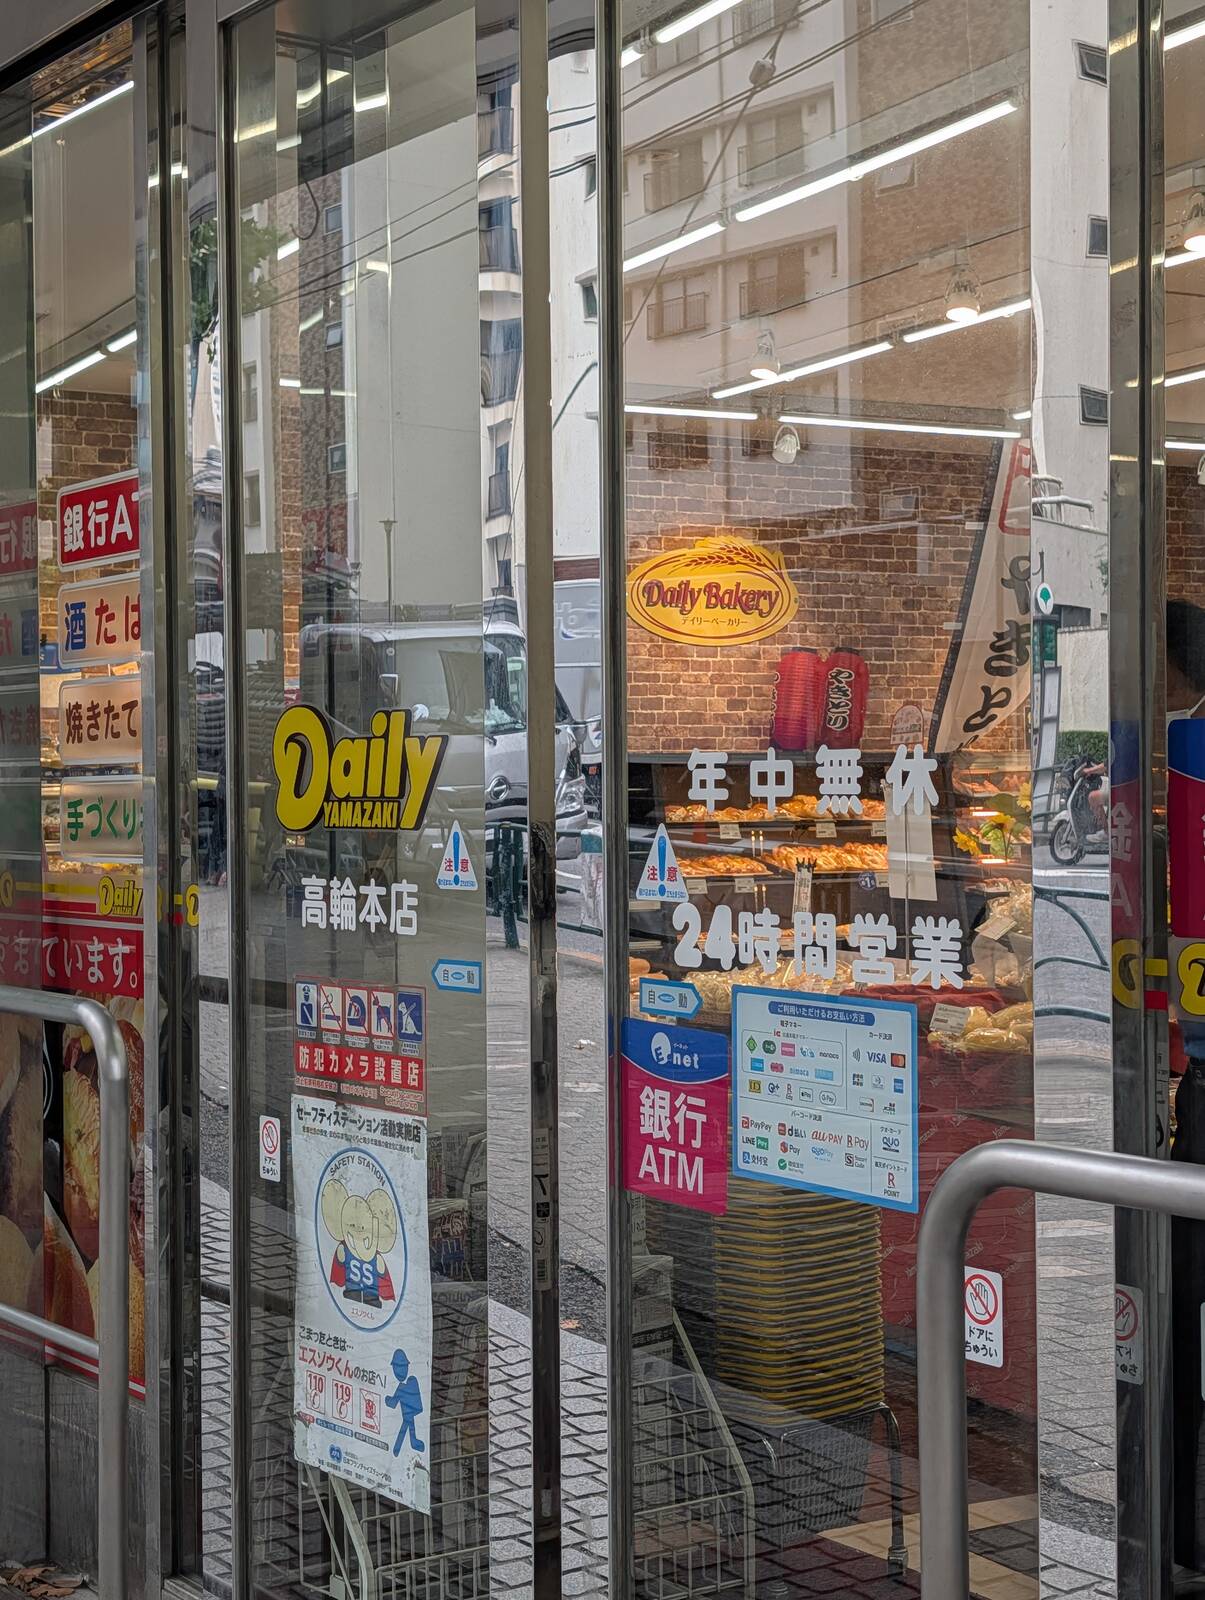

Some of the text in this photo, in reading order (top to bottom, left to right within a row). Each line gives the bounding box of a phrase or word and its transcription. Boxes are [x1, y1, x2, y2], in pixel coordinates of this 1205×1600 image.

[63, 493, 139, 552] 銀行A
[641, 578, 780, 618] Daily Bakery
[66, 699, 138, 744] 焼きたて
[273, 704, 449, 831] Daily
[687, 743, 939, 816] 年中無休
[323, 801, 399, 829] YAMAZAKI
[98, 876, 143, 917] Daily
[300, 874, 419, 936] 高輪本店
[672, 902, 964, 990] 24時間営業
[299, 1046, 419, 1087] 防犯カメラ設置店
[866, 1051, 887, 1064] VISA
[639, 1085, 707, 1149] 銀行
[750, 1120, 772, 1132] PayPay
[742, 1136, 755, 1146] LINE
[789, 1144, 800, 1155] Pay
[828, 1133, 843, 1145] PAY
[854, 1136, 869, 1151] Pay
[882, 1136, 899, 1147] QUO
[330, 1155, 386, 1187] SAFETY STATION
[638, 1143, 704, 1195] ATM
[884, 1188, 900, 1198] POINT
[350, 1260, 374, 1286] SS
[968, 1326, 994, 1343] ドアに
[965, 1343, 998, 1359] ちゅうい
[308, 1373, 324, 1394] 110
[334, 1382, 351, 1403] 119
